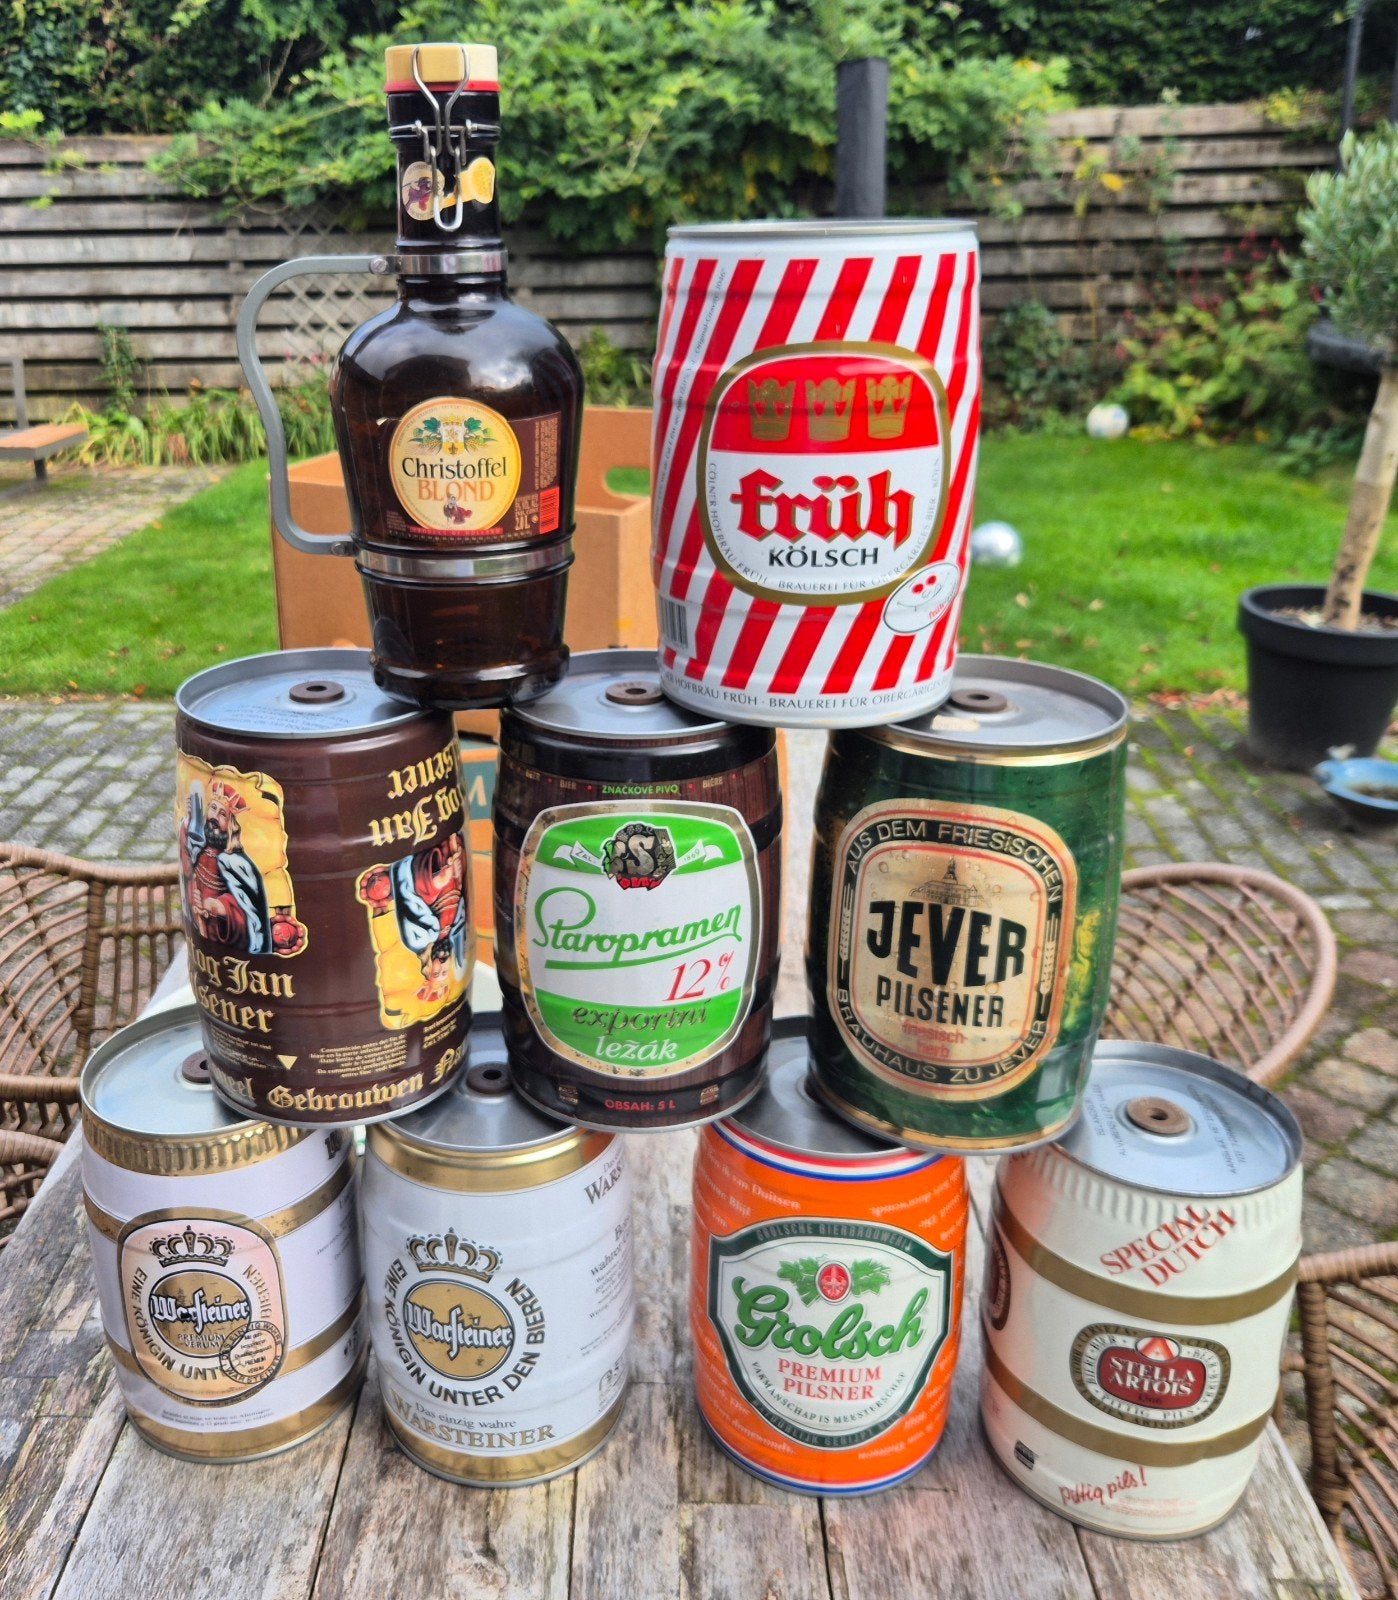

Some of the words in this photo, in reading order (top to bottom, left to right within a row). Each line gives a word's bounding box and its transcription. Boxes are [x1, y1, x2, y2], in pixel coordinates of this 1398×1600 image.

[401, 456, 507, 480] Christoffel
[418, 480, 495, 502] BLOND
[730, 468, 915, 551] früh
[710, 509, 737, 562] HOFBRÄU
[778, 580, 839, 592] BRAUEREI
[842, 579, 867, 590] FÜR
[768, 545, 879, 568] KÖLSCH
[675, 677, 720, 699] HOFBRÄU
[722, 691, 758, 706] FRÜH
[768, 696, 837, 709] BRAUEREI
[841, 695, 868, 708] FÜR
[601, 783, 654, 795] ZNAČKOVÉ
[655, 783, 679, 794] PIVO
[368, 794, 438, 847] Jan
[846, 831, 873, 875] AUS
[876, 820, 927, 841] DEM
[937, 822, 1062, 903] FRIESISCHEN
[532, 886, 742, 963] Staropramen
[866, 900, 1028, 987] JEVER
[223, 956, 296, 999] Jan
[571, 999, 712, 1036] exportní
[876, 974, 1004, 1028] PILSENER
[594, 1036, 679, 1061] ležák
[837, 988, 937, 1080] BRAUHAUS
[948, 1066, 982, 1083] ZU
[988, 1019, 1047, 1077] JEVER
[267, 1071, 424, 1112] Gebrouwen
[604, 1099, 654, 1111] OBSAH:
[658, 1101, 665, 1111] 5
[669, 1100, 677, 1109] L
[1099, 1205, 1212, 1276] SPECIAL
[1141, 1207, 1238, 1287] DUTCH
[132, 1266, 148, 1302] EINE
[384, 1258, 409, 1298] EINE
[504, 1277, 546, 1345] BIEREN
[731, 1276, 929, 1361] Grolsch
[132, 1303, 176, 1371] KÖNIGIN
[185, 1341, 221, 1349] VERUM
[385, 1295, 427, 1385] KÖNIGIN
[502, 1351, 541, 1392] DEN
[777, 1357, 881, 1383] PREMIUM
[783, 1376, 875, 1401] PILSNER
[1109, 1356, 1197, 1384] STELLA
[1109, 1371, 1193, 1397] ARTOIS
[428, 1380, 505, 1407] UNTER
[752, 1361, 817, 1422] VAKMANSCHAP
[818, 1415, 830, 1424] IS
[391, 1390, 556, 1449] WARSTEINER
[415, 1402, 436, 1420] Das
[438, 1412, 475, 1430] einzig
[478, 1419, 517, 1430] wahre
[1107, 1465, 1148, 1499] pils!
